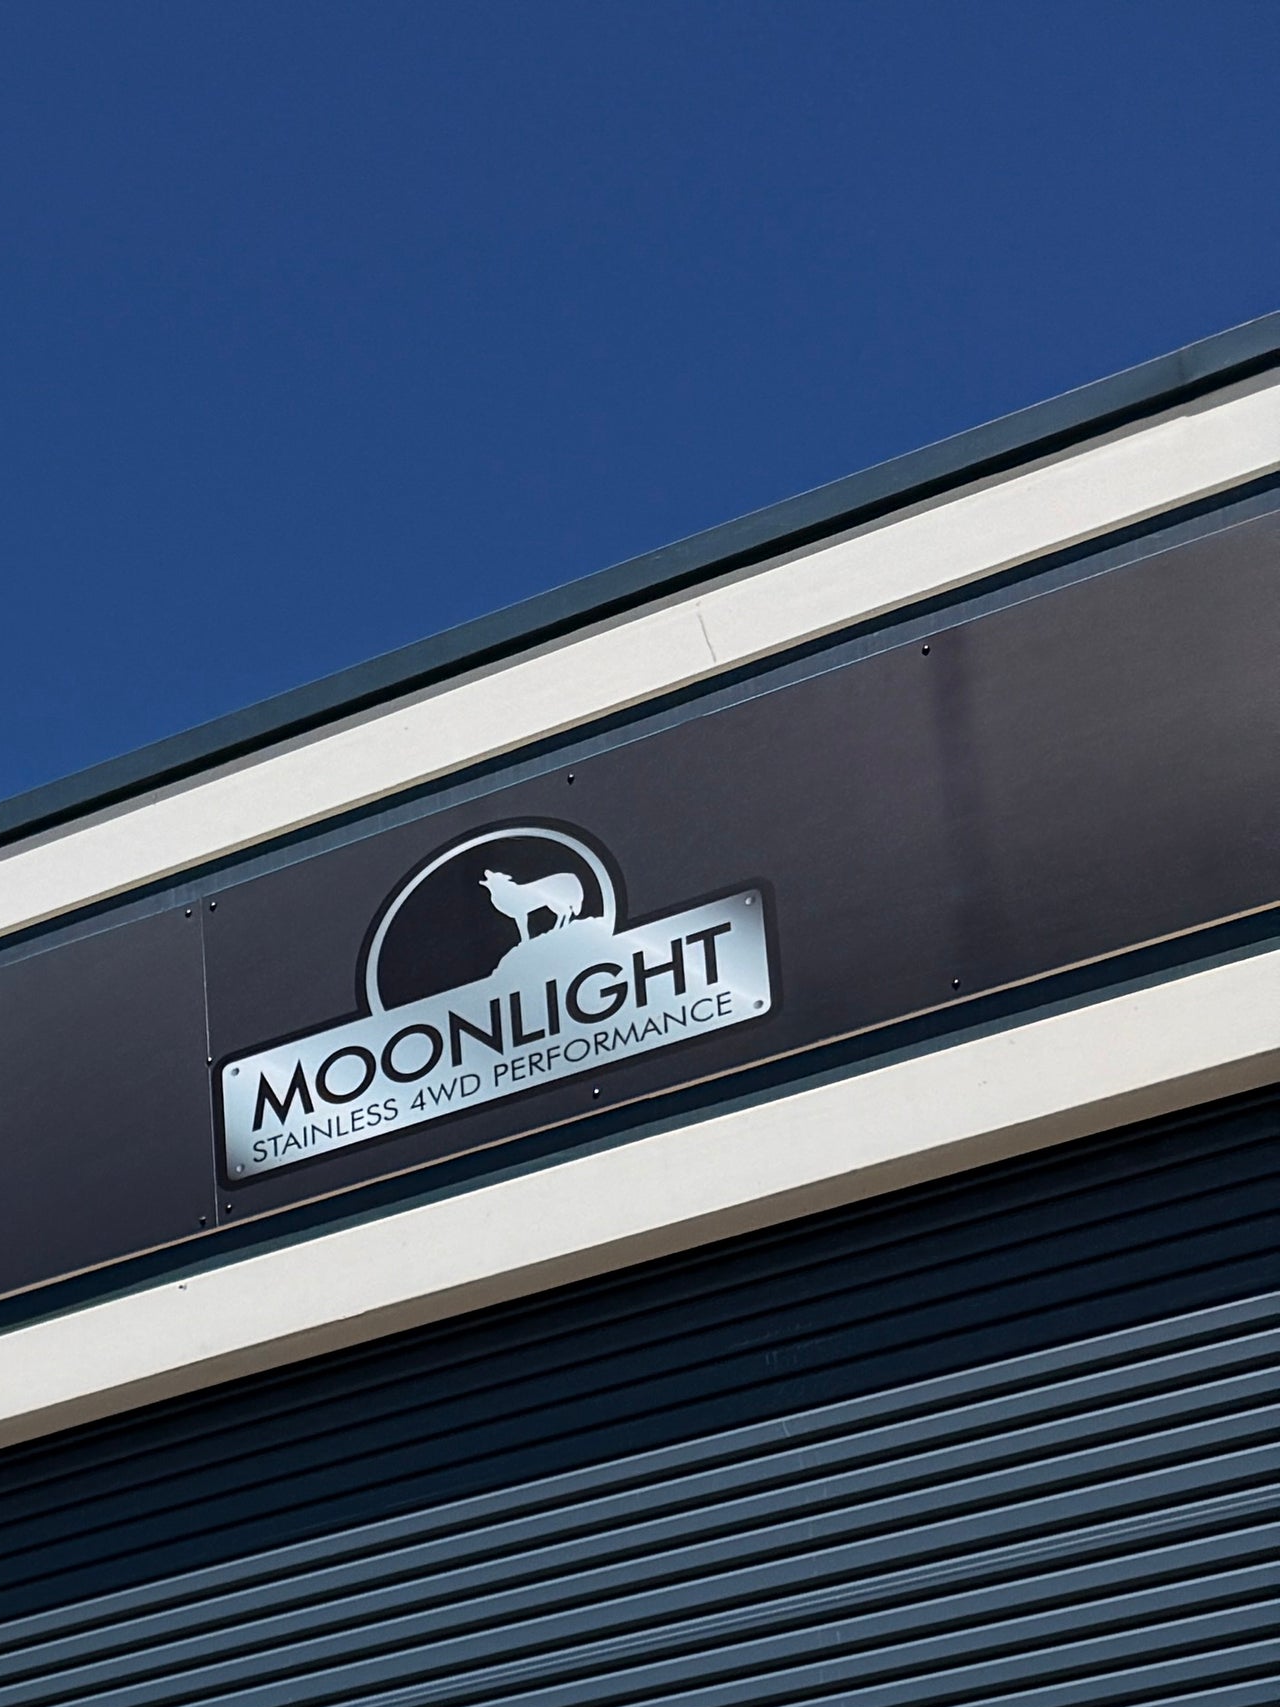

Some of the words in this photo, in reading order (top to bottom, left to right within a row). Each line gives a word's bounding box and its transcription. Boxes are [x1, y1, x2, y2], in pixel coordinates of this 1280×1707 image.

[251, 922, 732, 1132] MOONLIGHT
[252, 1099, 398, 1164] STAINLESS
[410, 1074, 481, 1112] 4WD
[494, 990, 733, 1088] PERFORMANCE
